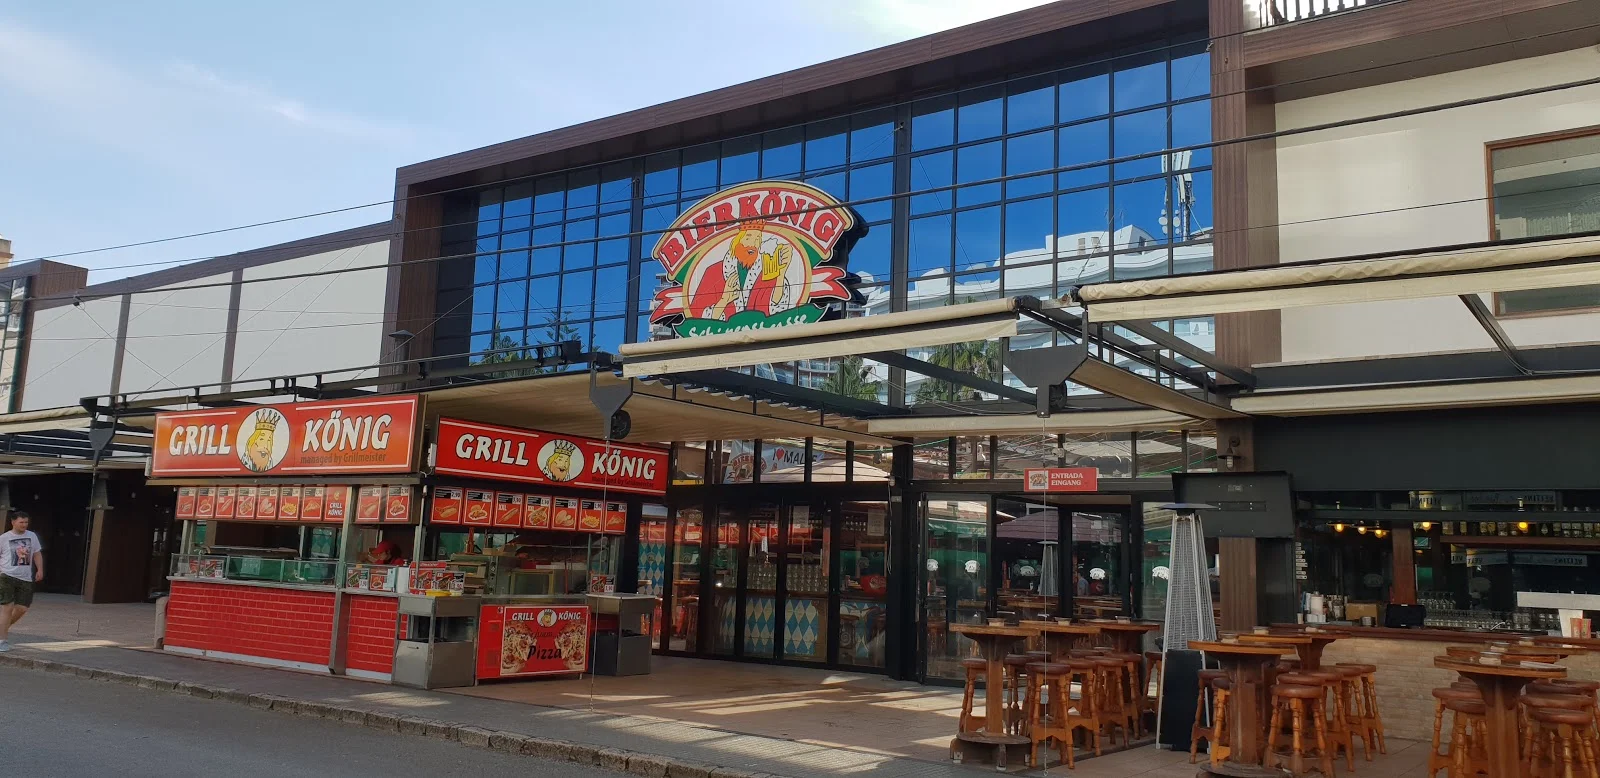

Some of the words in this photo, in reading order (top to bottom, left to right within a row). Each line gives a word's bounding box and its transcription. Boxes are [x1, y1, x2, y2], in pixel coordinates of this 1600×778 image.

[660, 188, 840, 268] BIERKÖNIG
[168, 423, 231, 456] GRILL
[301, 409, 392, 453] KÖNIG
[300, 454, 333, 467] managed
[333, 453, 343, 464] by
[343, 451, 387, 463] Grillmeister
[456, 433, 529, 466] GRILL
[591, 449, 656, 480] KÖNIG
[1051, 472, 1083, 480] ENTRADA
[511, 612, 534, 621] GRILL
[558, 610, 581, 620] KÖNIG
[527, 645, 562, 660] Pizza
